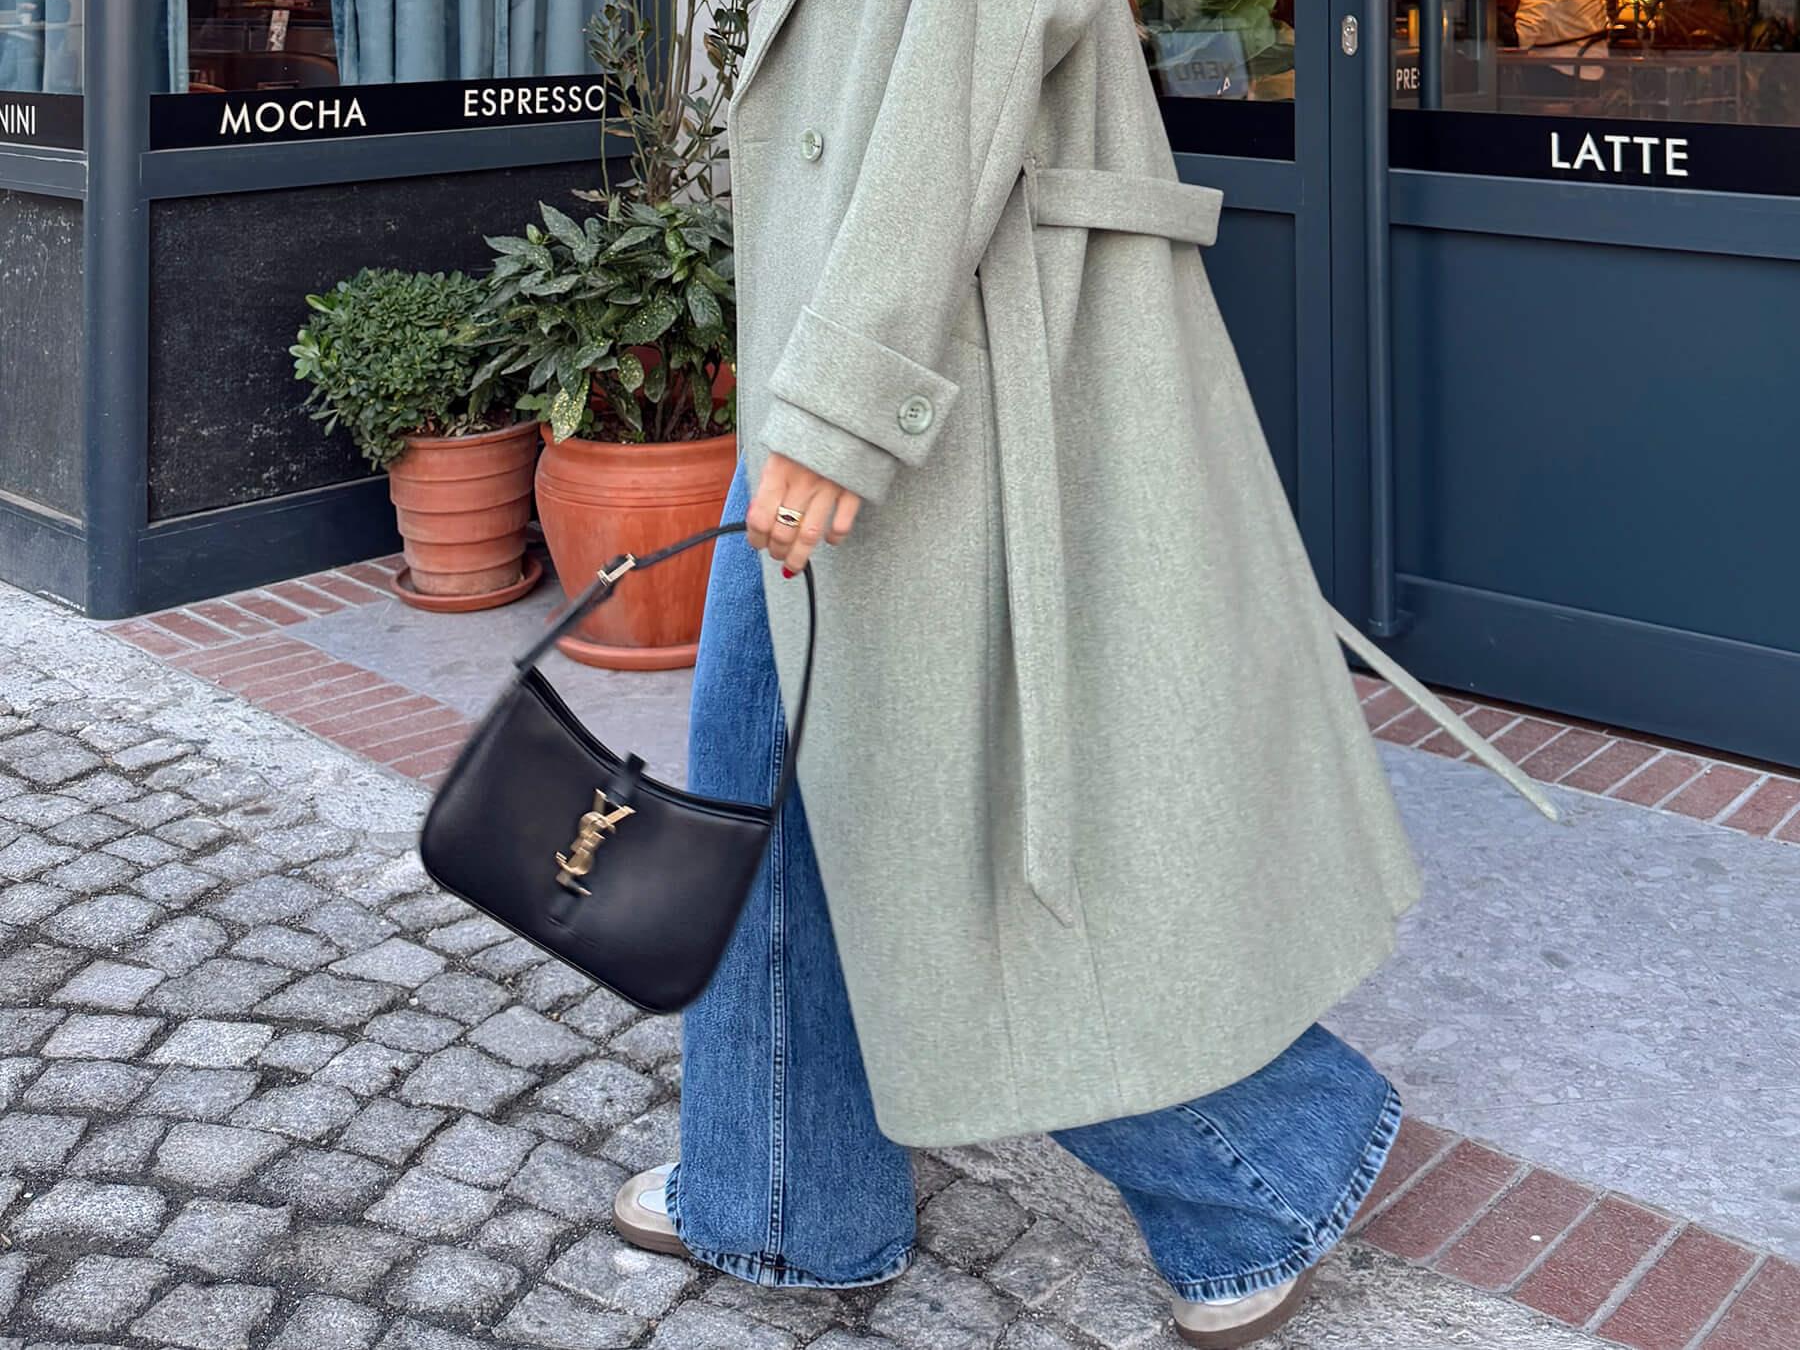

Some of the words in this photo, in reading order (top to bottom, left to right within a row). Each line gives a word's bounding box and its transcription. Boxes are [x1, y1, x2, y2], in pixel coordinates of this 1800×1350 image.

[219, 97, 367, 135] MOCHA
[464, 85, 605, 117] ESPRESSO
[1551, 132, 1689, 176] LATTE
